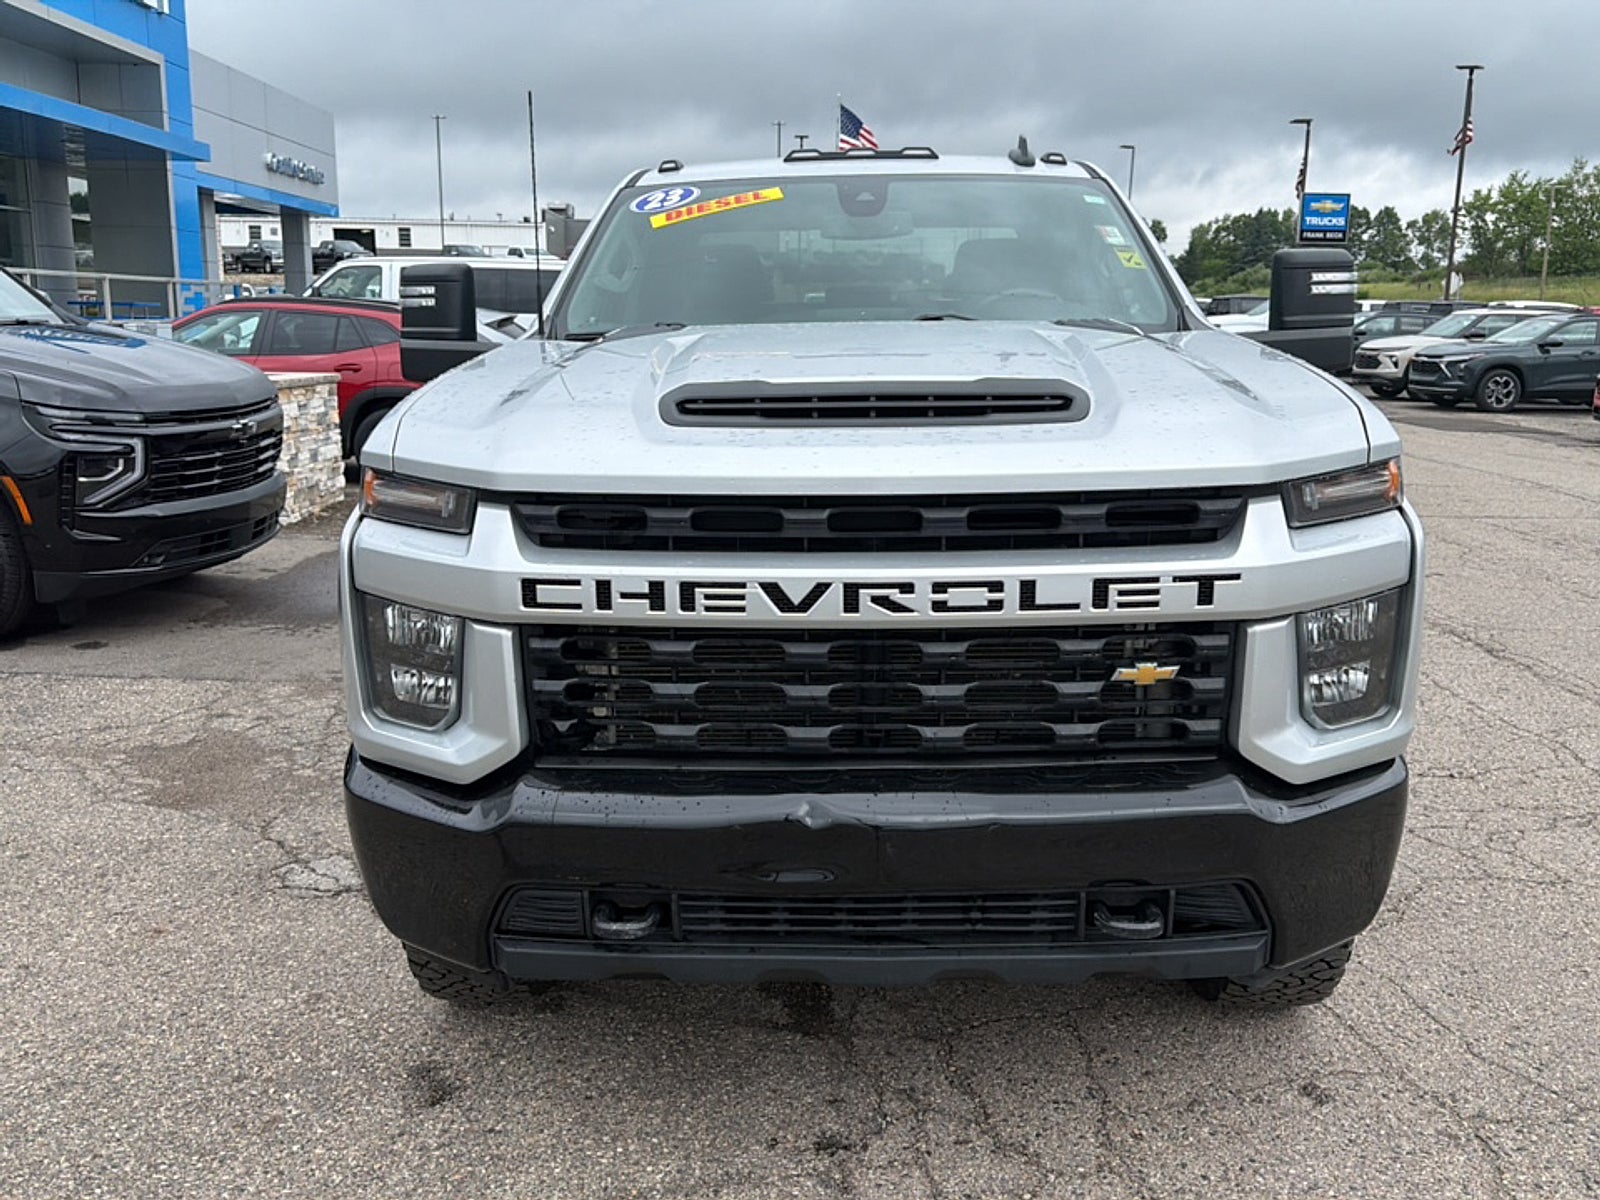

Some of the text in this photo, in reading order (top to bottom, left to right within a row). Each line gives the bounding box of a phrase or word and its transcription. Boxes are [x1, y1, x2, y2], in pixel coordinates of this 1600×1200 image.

[644, 187, 684, 210] 23
[665, 191, 771, 222] DIESEL
[1305, 217, 1345, 226] TRUCKS
[520, 573, 1241, 615] CHEVROLET
